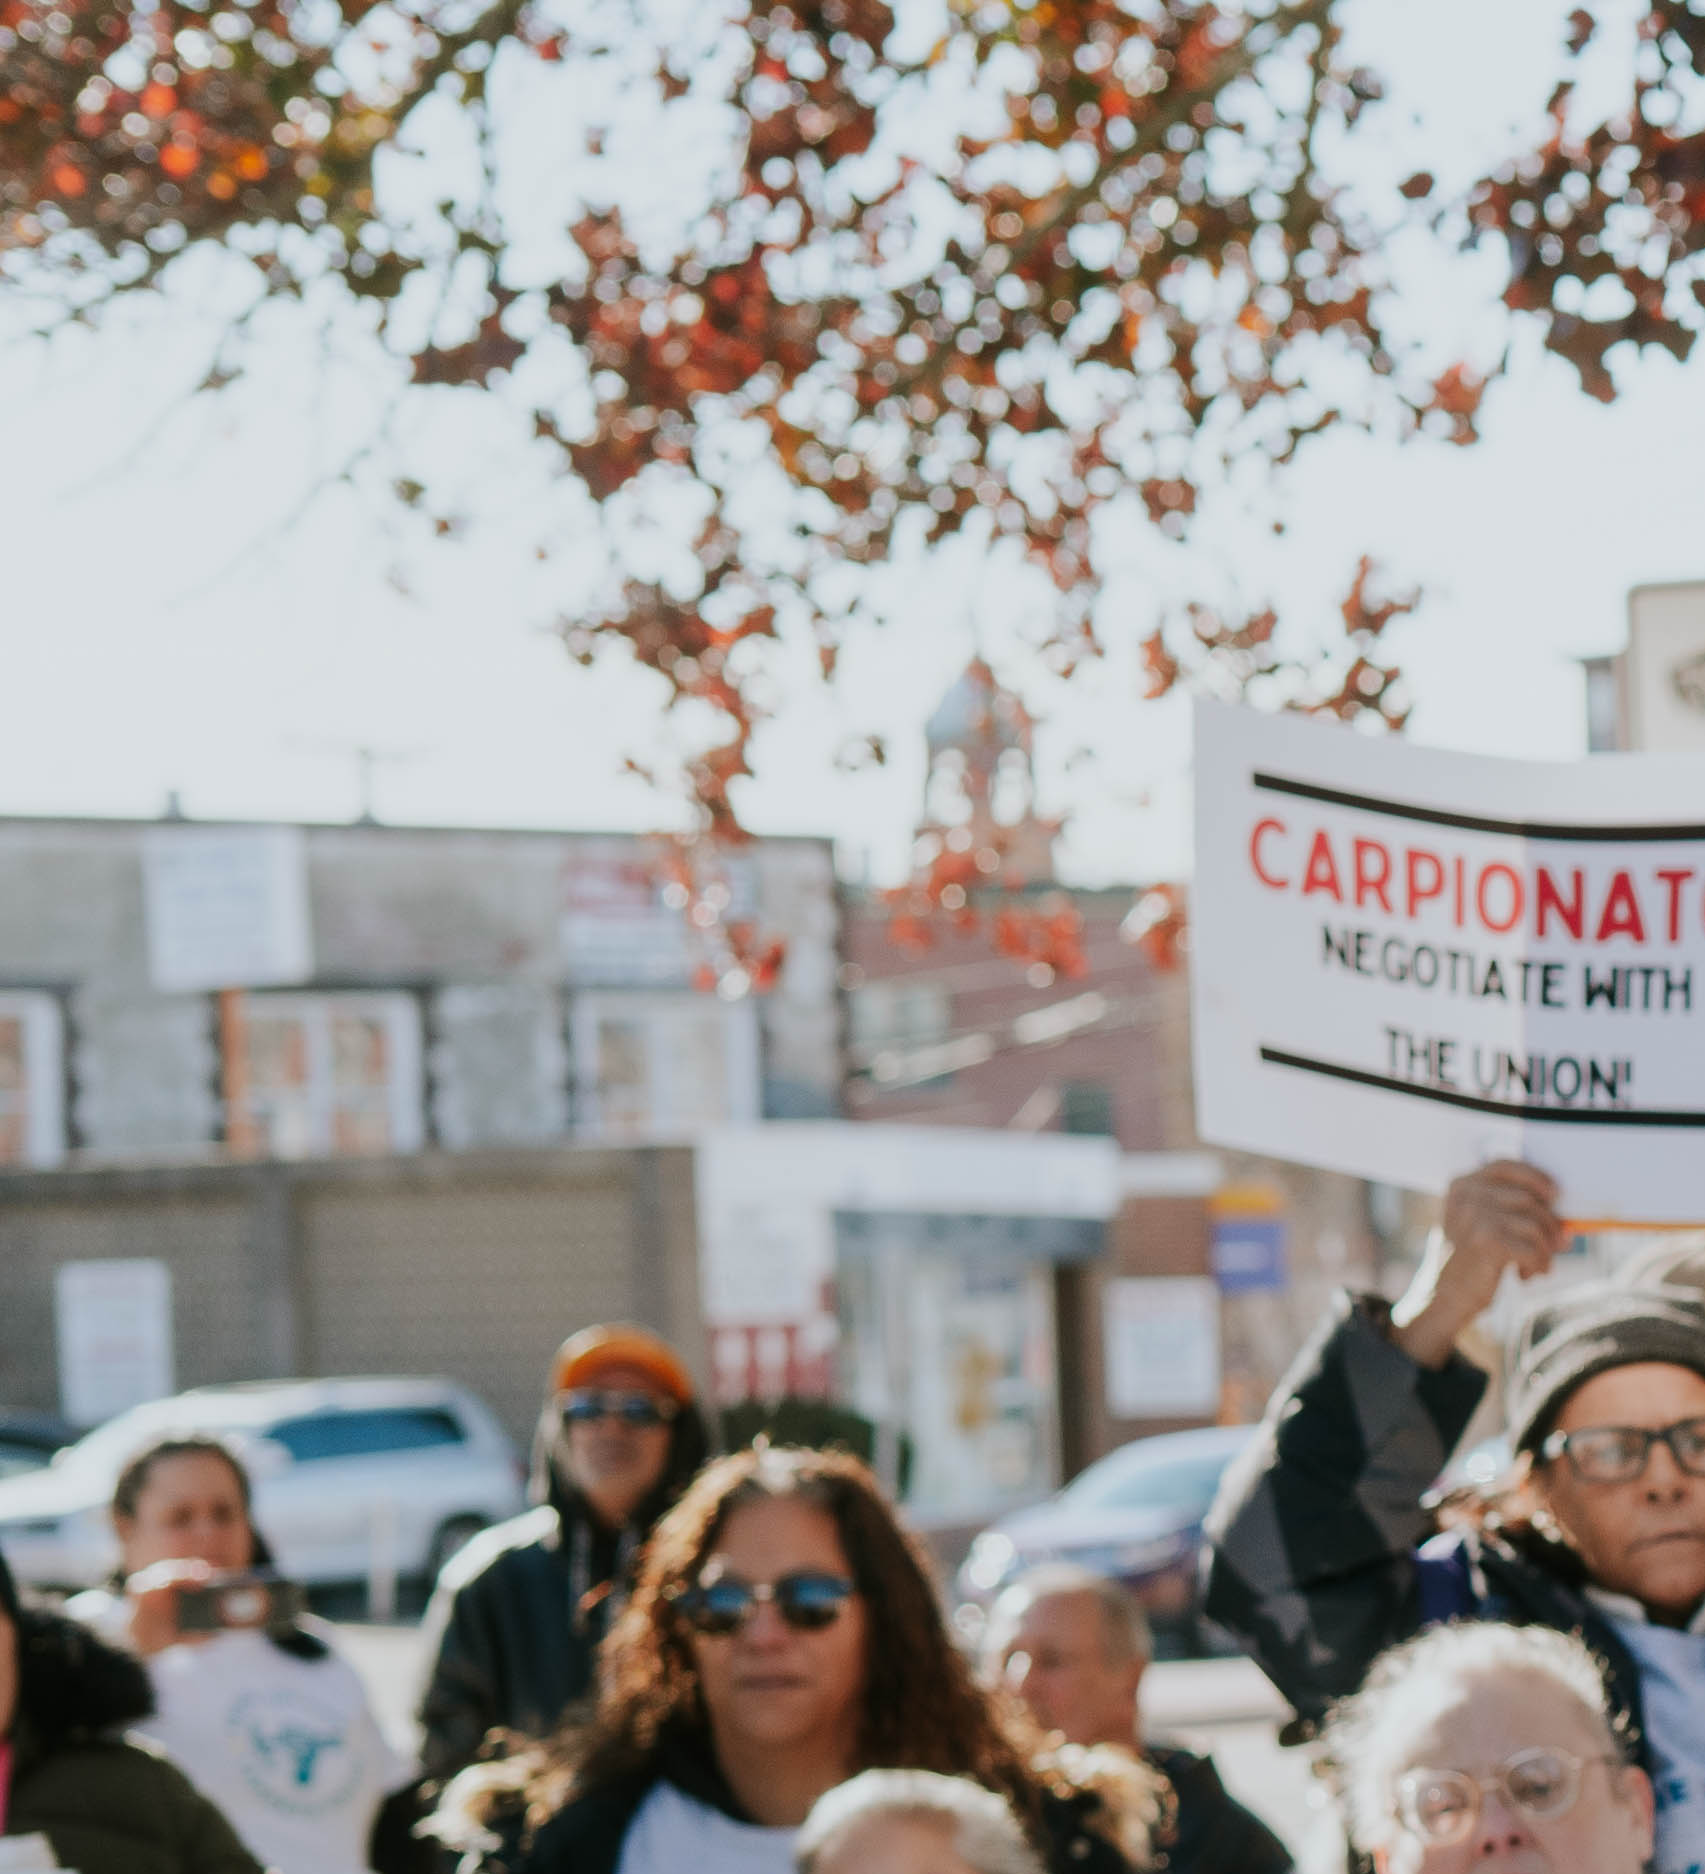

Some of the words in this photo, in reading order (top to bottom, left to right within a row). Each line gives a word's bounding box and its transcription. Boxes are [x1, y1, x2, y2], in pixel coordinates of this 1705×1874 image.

[1321, 924, 1566, 1010] NEGOTIATE
[1583, 964, 1693, 1012] WITH
[1384, 1026, 1457, 1084] THE
